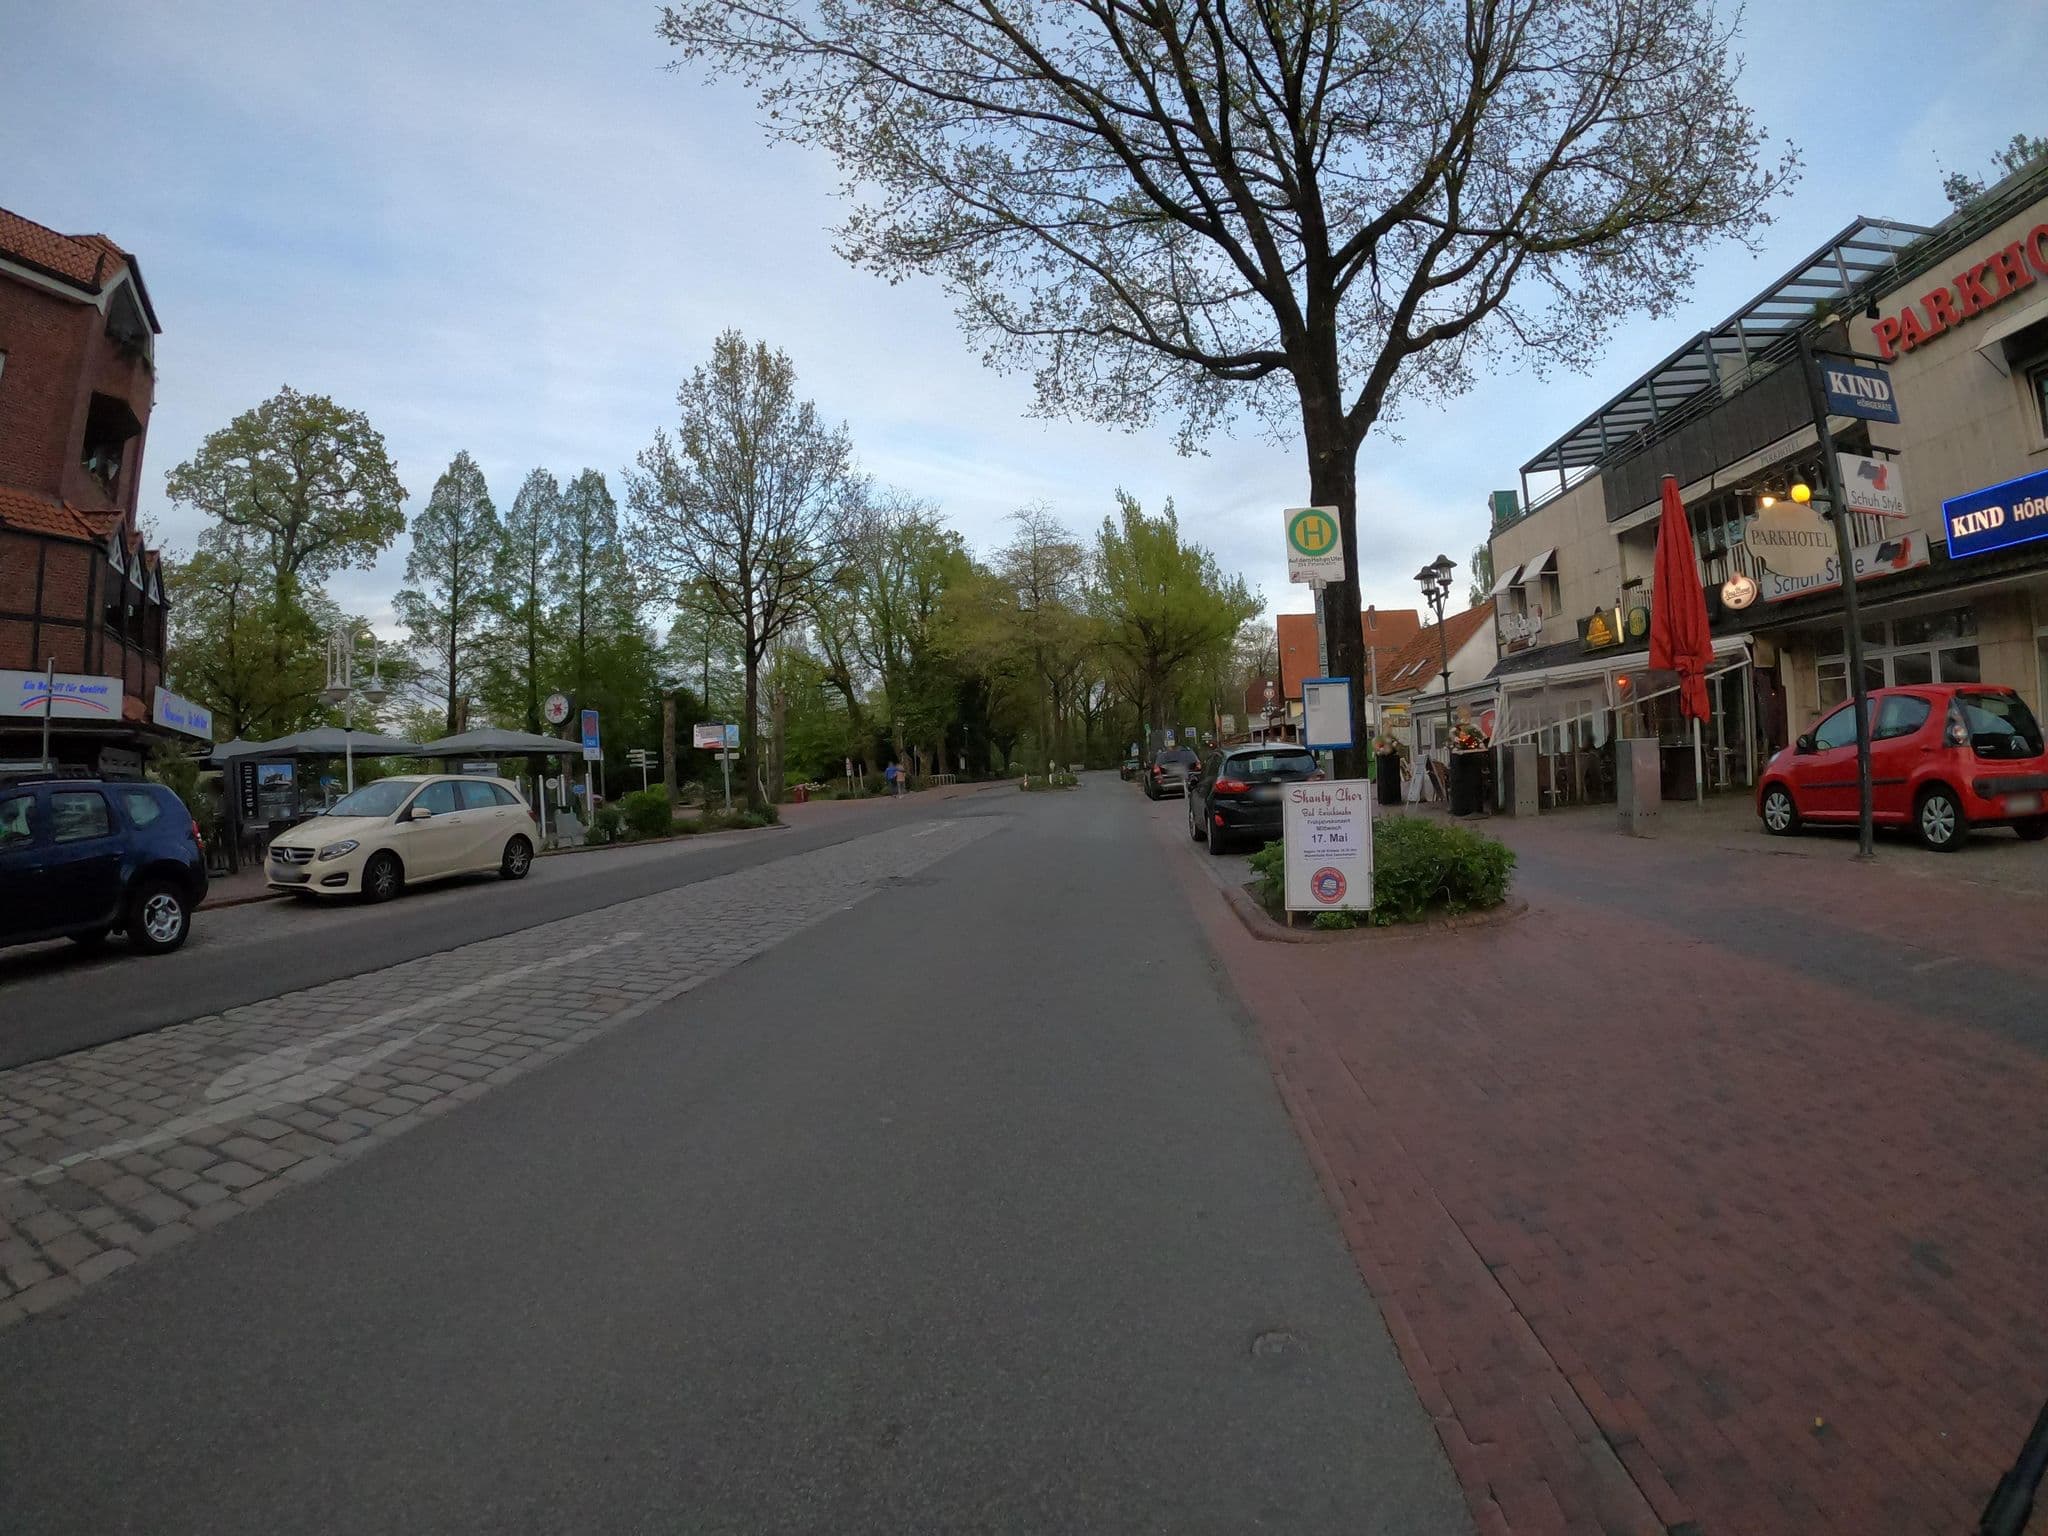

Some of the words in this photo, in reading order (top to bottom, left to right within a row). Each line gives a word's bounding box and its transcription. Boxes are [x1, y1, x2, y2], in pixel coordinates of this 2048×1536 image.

[1827, 371, 1890, 401] KIND
[1851, 490, 1880, 507] Schuh
[1881, 495, 1903, 513] Style
[1951, 506, 2005, 537] KIND
[2013, 496, 2048, 522] HÖR
[1303, 519, 1324, 546] H
[1751, 529, 1833, 549] PARKHOTEL
[1291, 789, 1333, 806] Shanty
[1336, 787, 1363, 802] Chor
[1301, 808, 1315, 817] Bad
[1311, 833, 1327, 843] 17.
[1330, 832, 1348, 843] Mai
